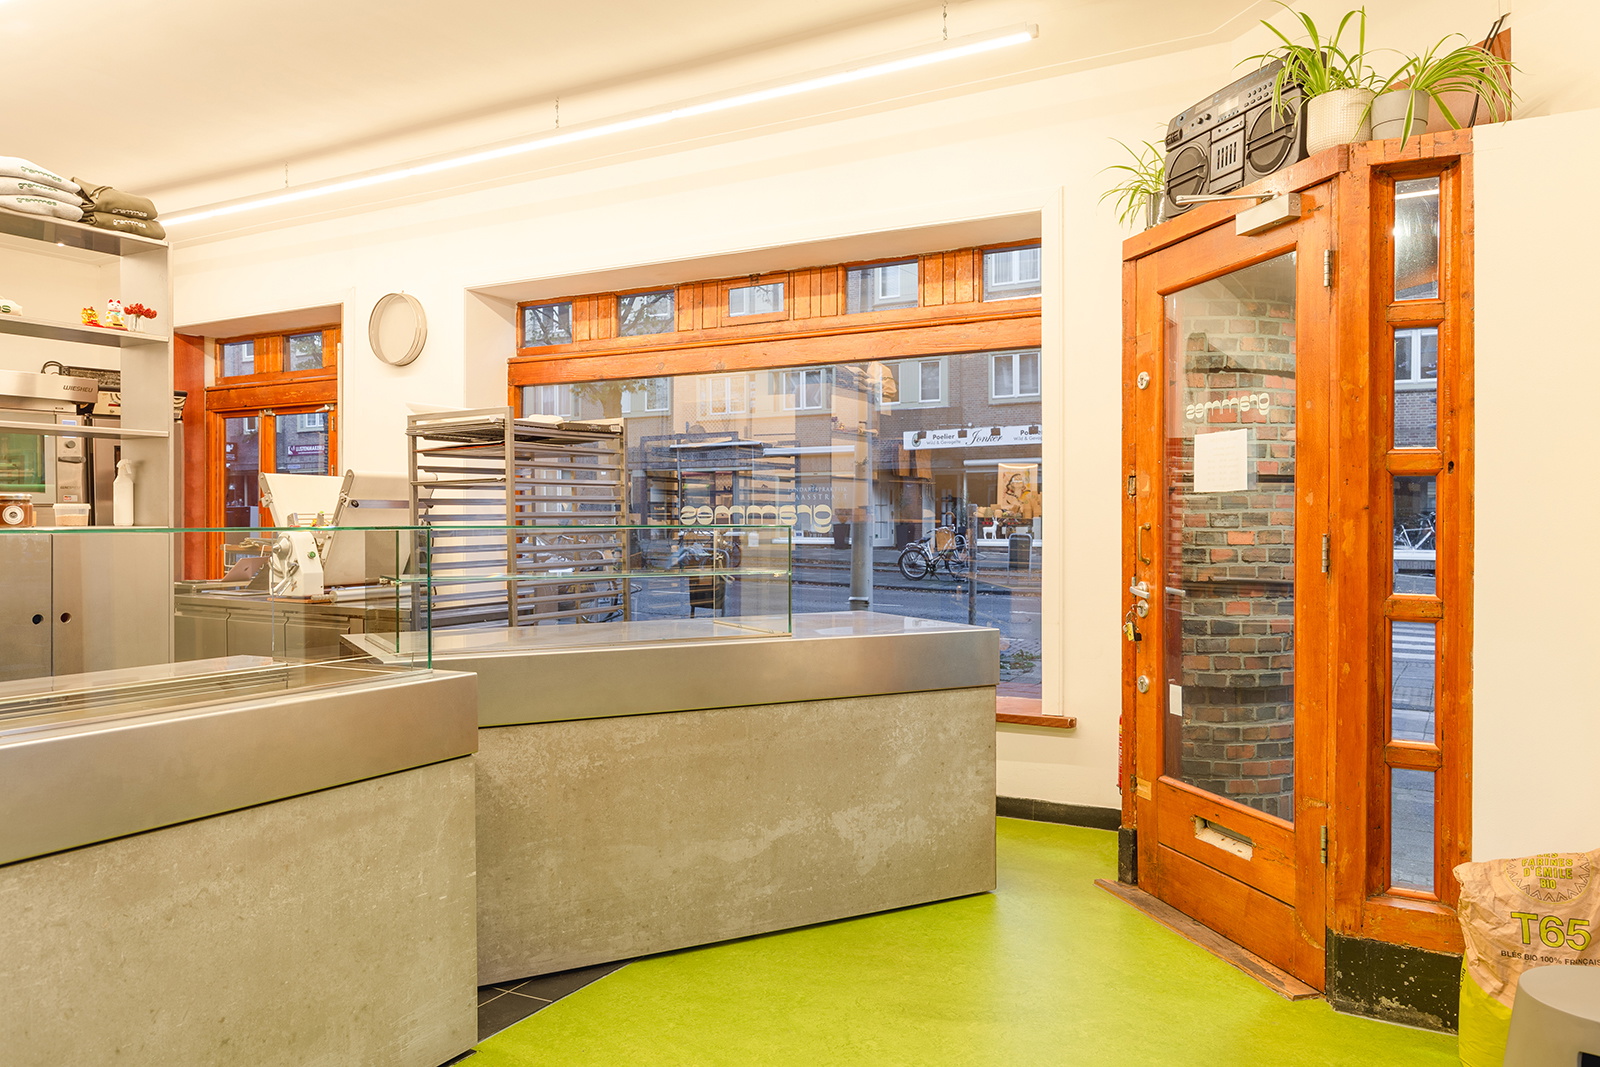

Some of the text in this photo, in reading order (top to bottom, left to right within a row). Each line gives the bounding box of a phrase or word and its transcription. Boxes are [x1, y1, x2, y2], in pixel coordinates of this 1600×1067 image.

[965, 429, 1003, 445] Jonker
[1521, 858, 1573, 867] FARINES
[1540, 878, 1557, 889] BIO
[1510, 912, 1592, 951] T65
[1501, 950, 1522, 959] BLÉS
[1524, 954, 1538, 962] BIO
[1540, 956, 1562, 964] 100%
